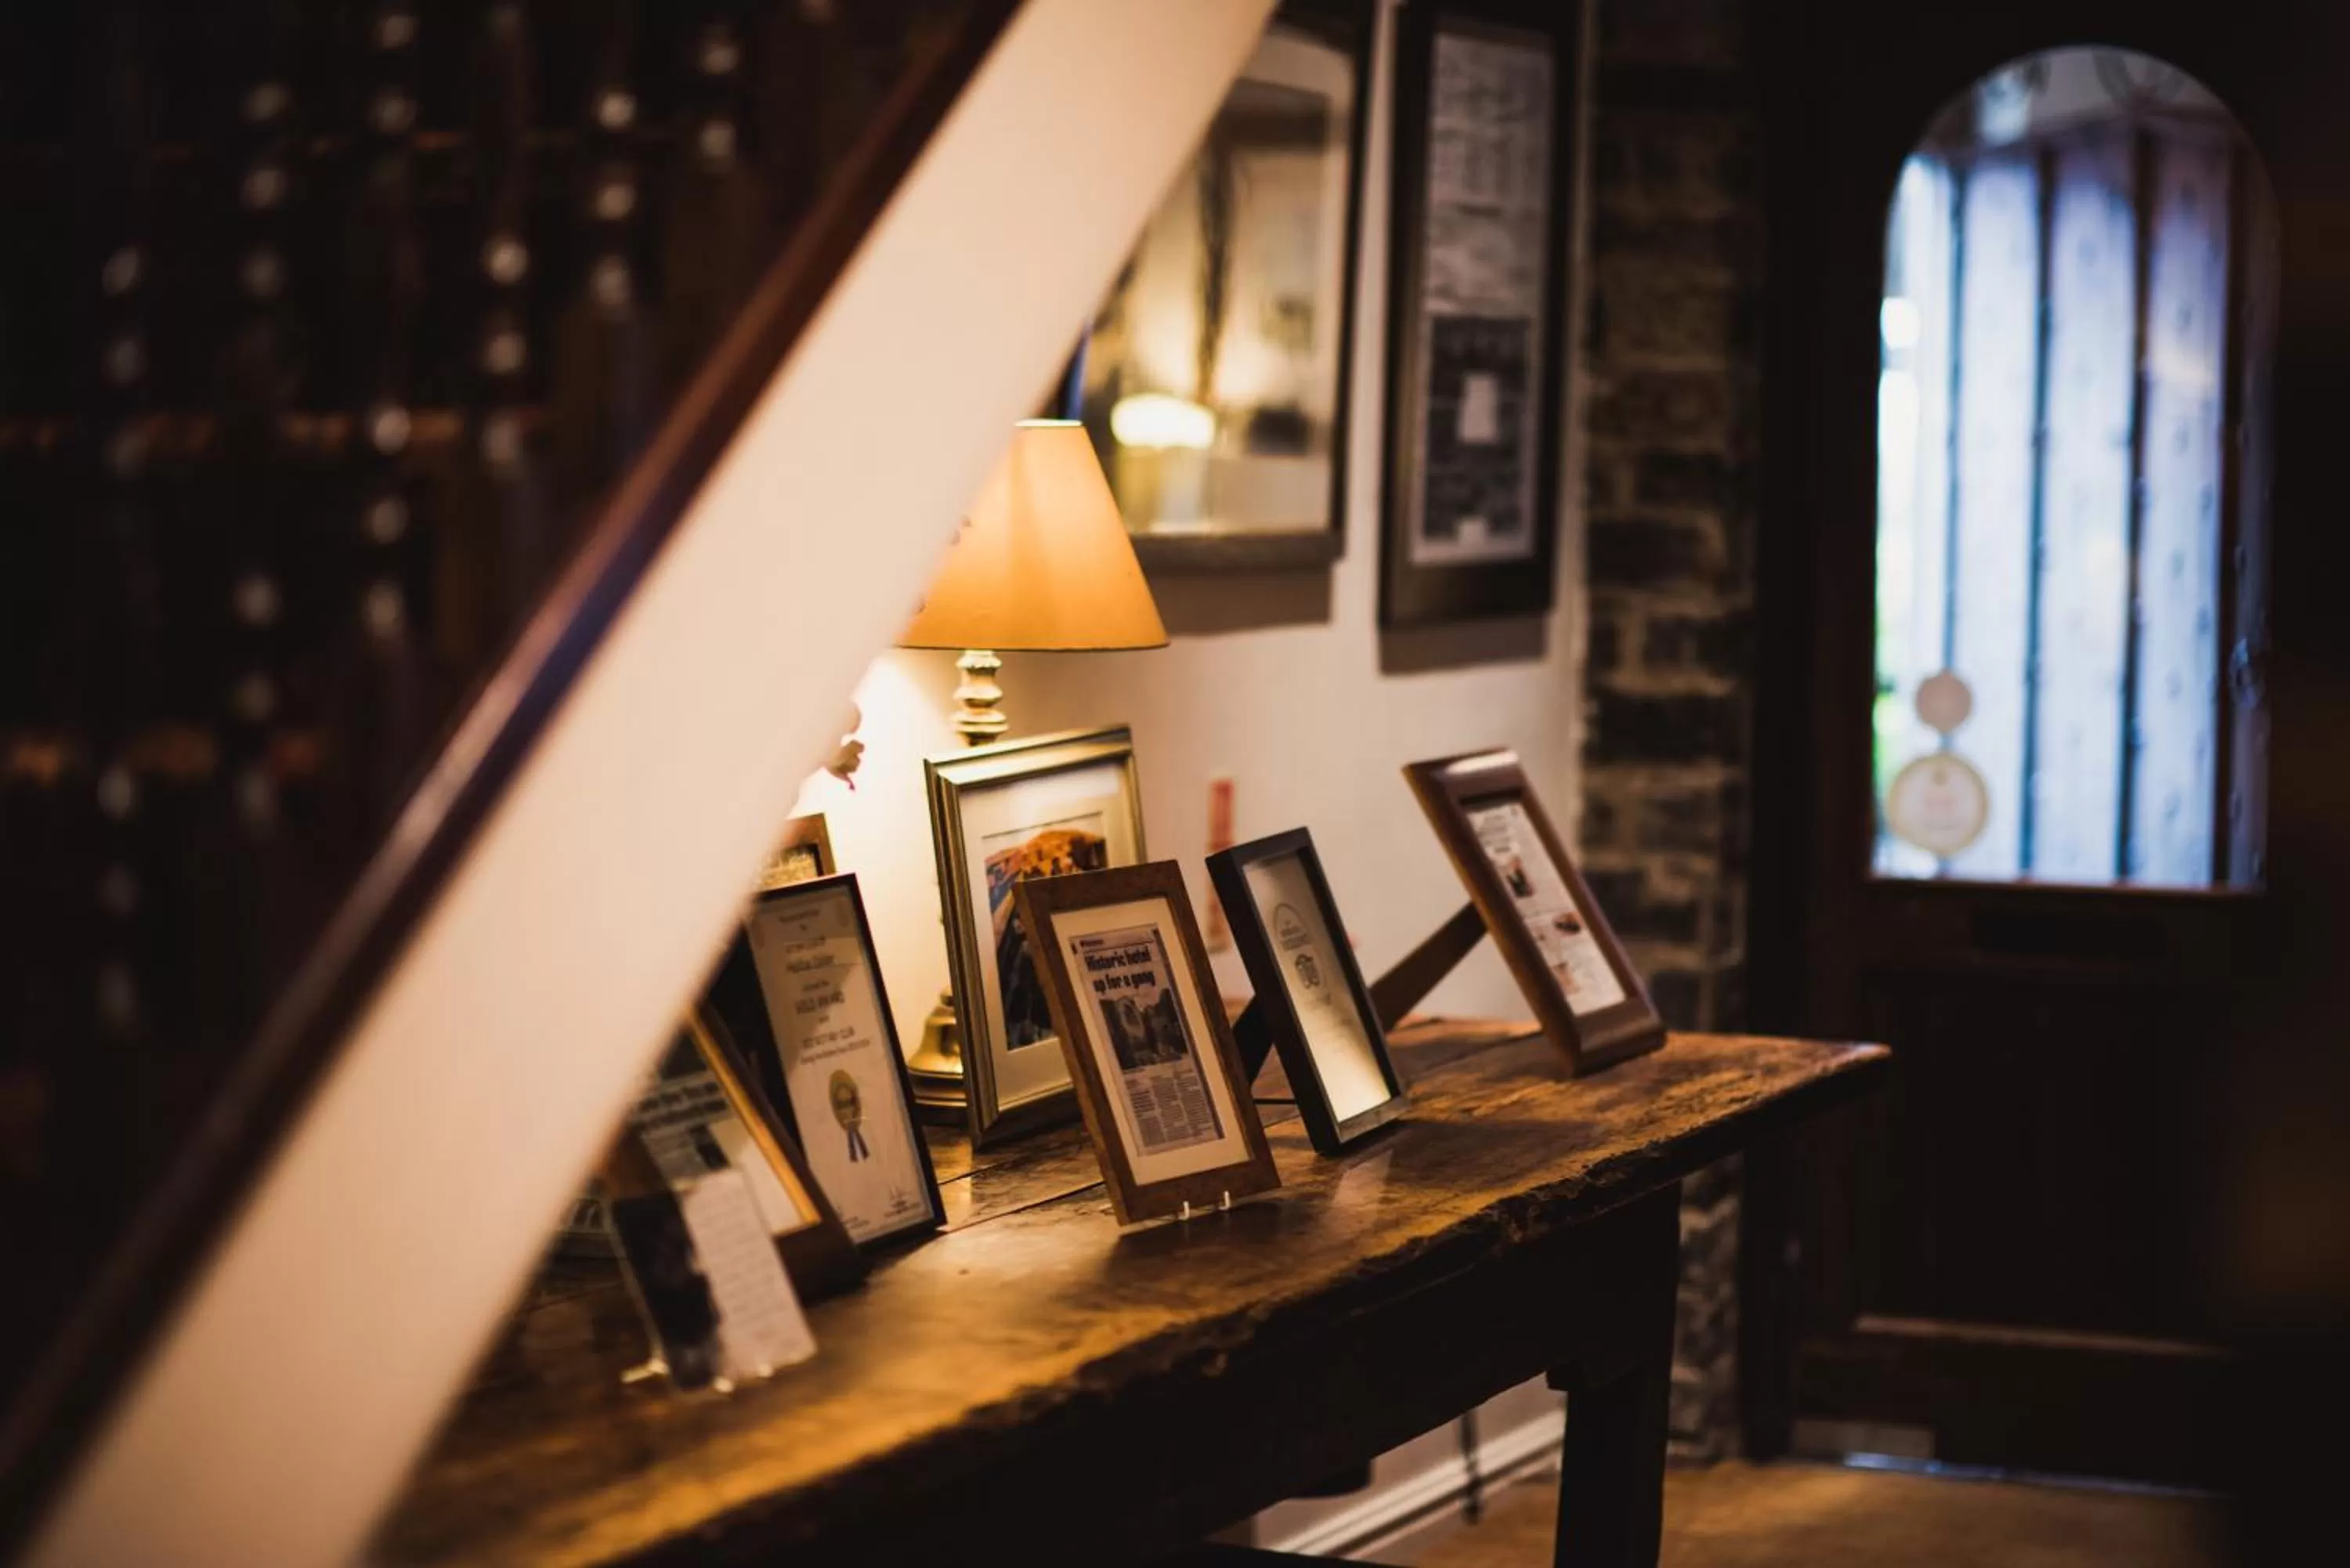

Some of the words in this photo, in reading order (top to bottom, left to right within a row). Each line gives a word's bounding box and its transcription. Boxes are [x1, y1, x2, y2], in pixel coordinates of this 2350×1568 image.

[1084, 951, 1126, 971] Historic
[1124, 945, 1152, 964] hotel
[1093, 979, 1106, 995] up
[1105, 974, 1122, 990] for
[1123, 975, 1131, 987] a
